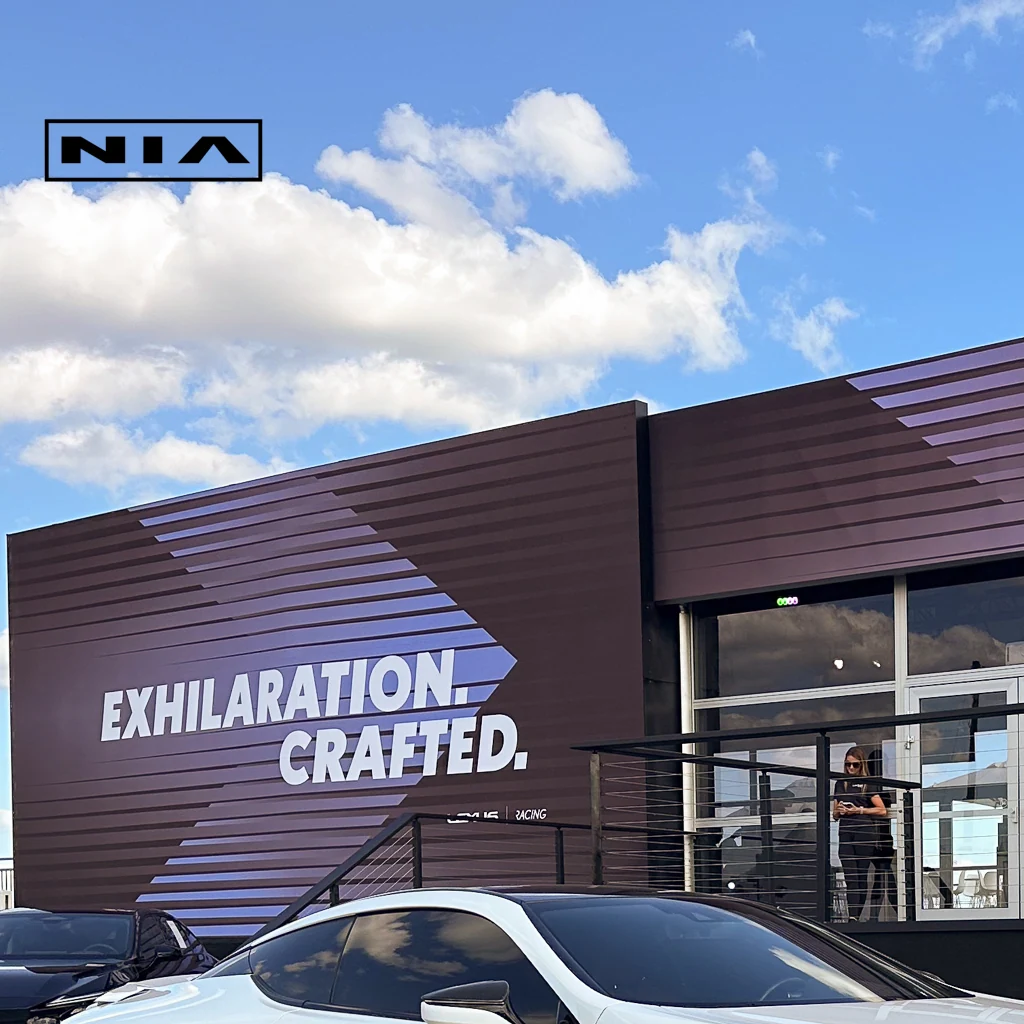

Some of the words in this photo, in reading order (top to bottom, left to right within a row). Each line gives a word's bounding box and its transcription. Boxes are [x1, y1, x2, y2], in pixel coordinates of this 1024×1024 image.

[100, 649, 468, 742] EXHILARATION.
[278, 713, 529, 786] CRAFTED.
[515, 808, 547, 821] RACING
